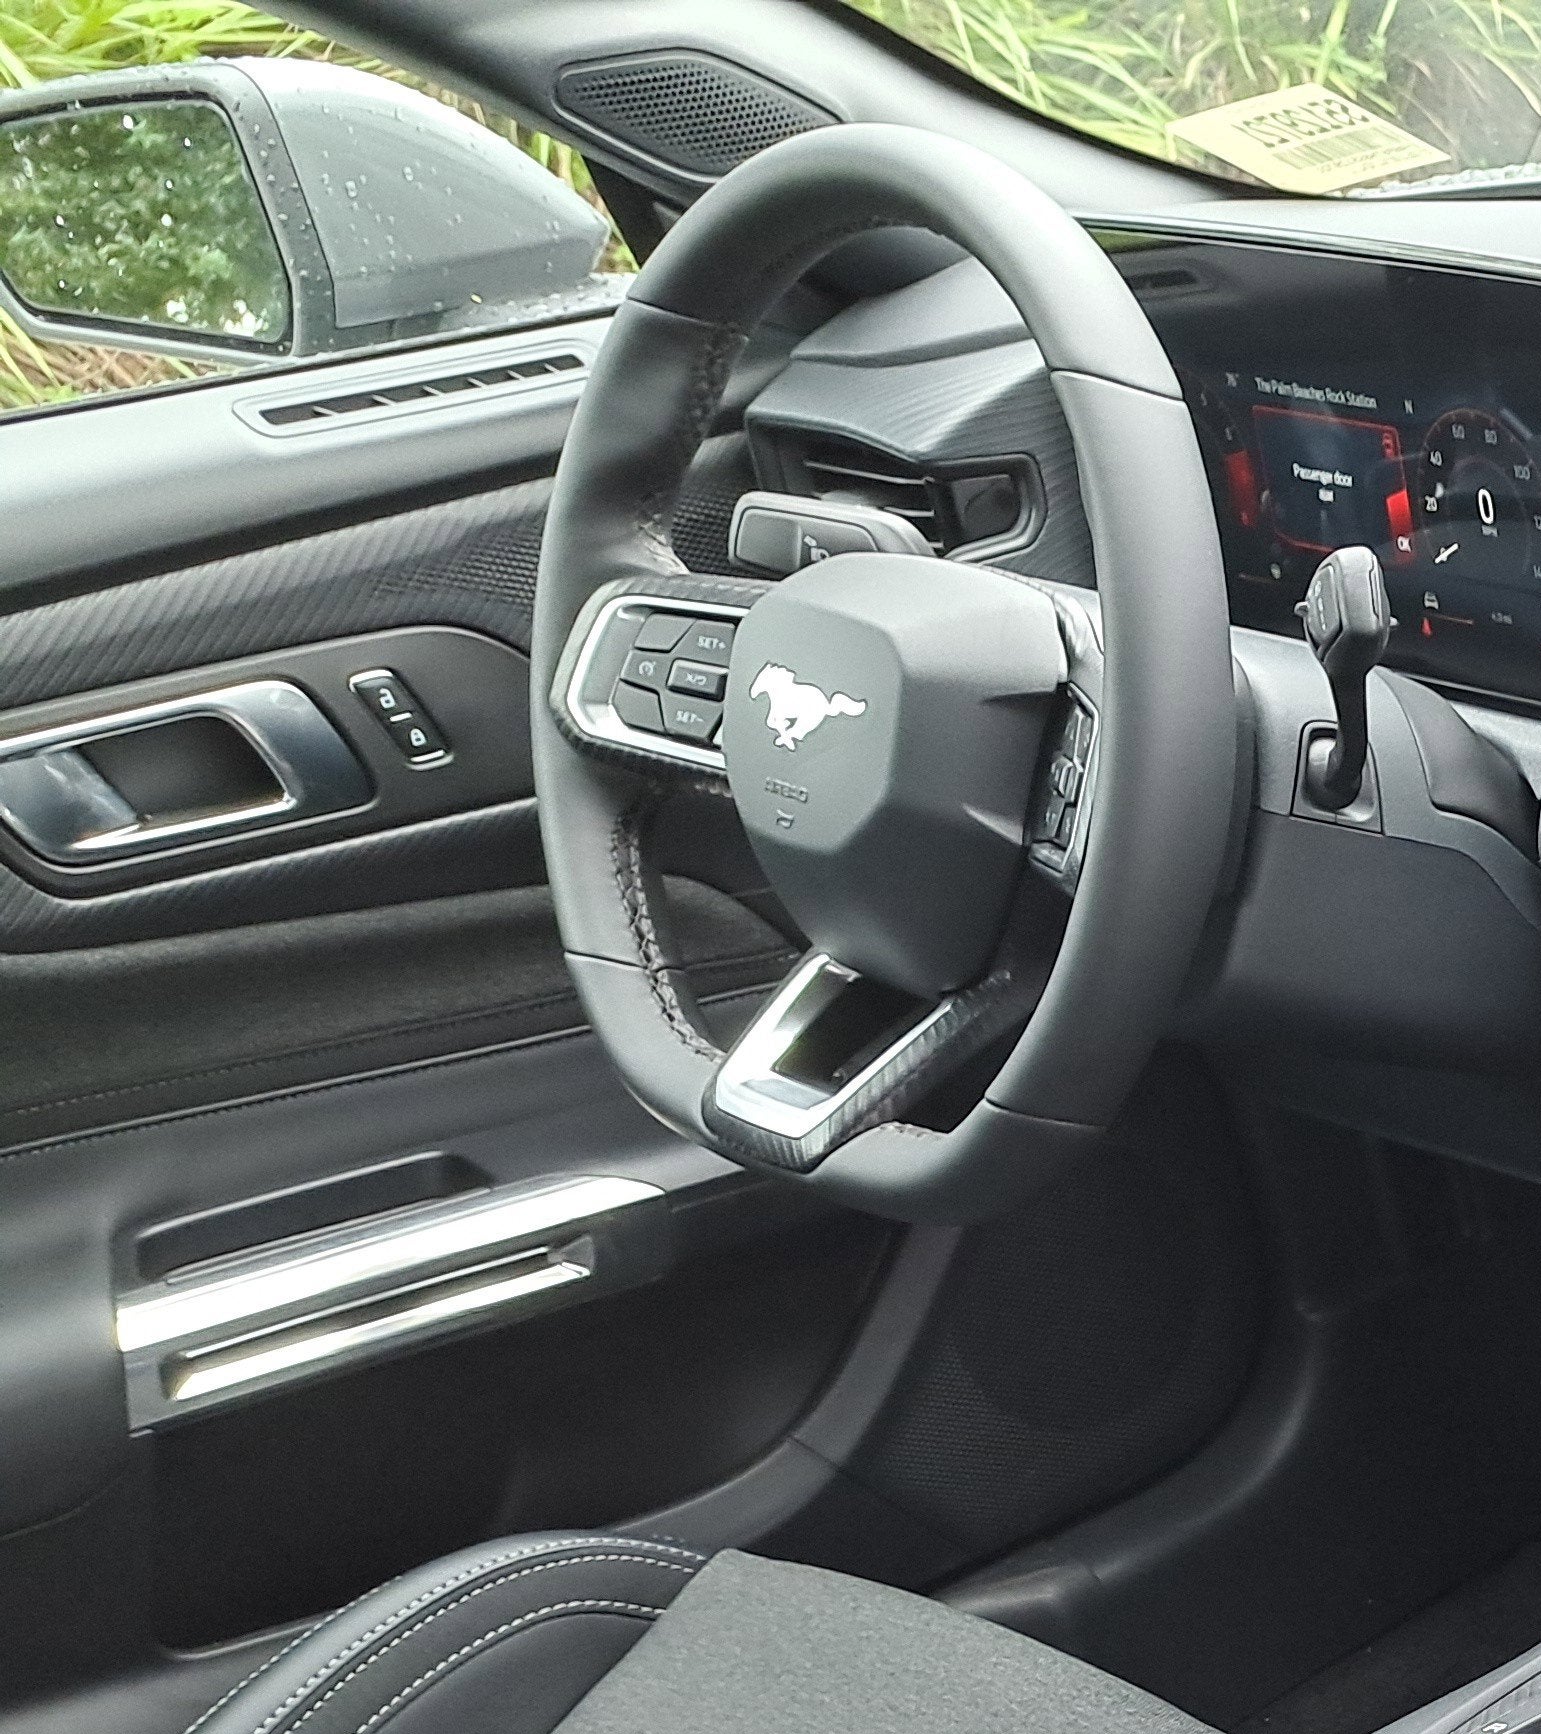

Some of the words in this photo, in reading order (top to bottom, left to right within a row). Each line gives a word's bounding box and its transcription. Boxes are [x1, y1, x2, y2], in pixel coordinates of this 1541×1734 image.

[1254, 376, 1271, 394] The
[1345, 390, 1379, 411] Station
[1477, 487, 1495, 526] 0
